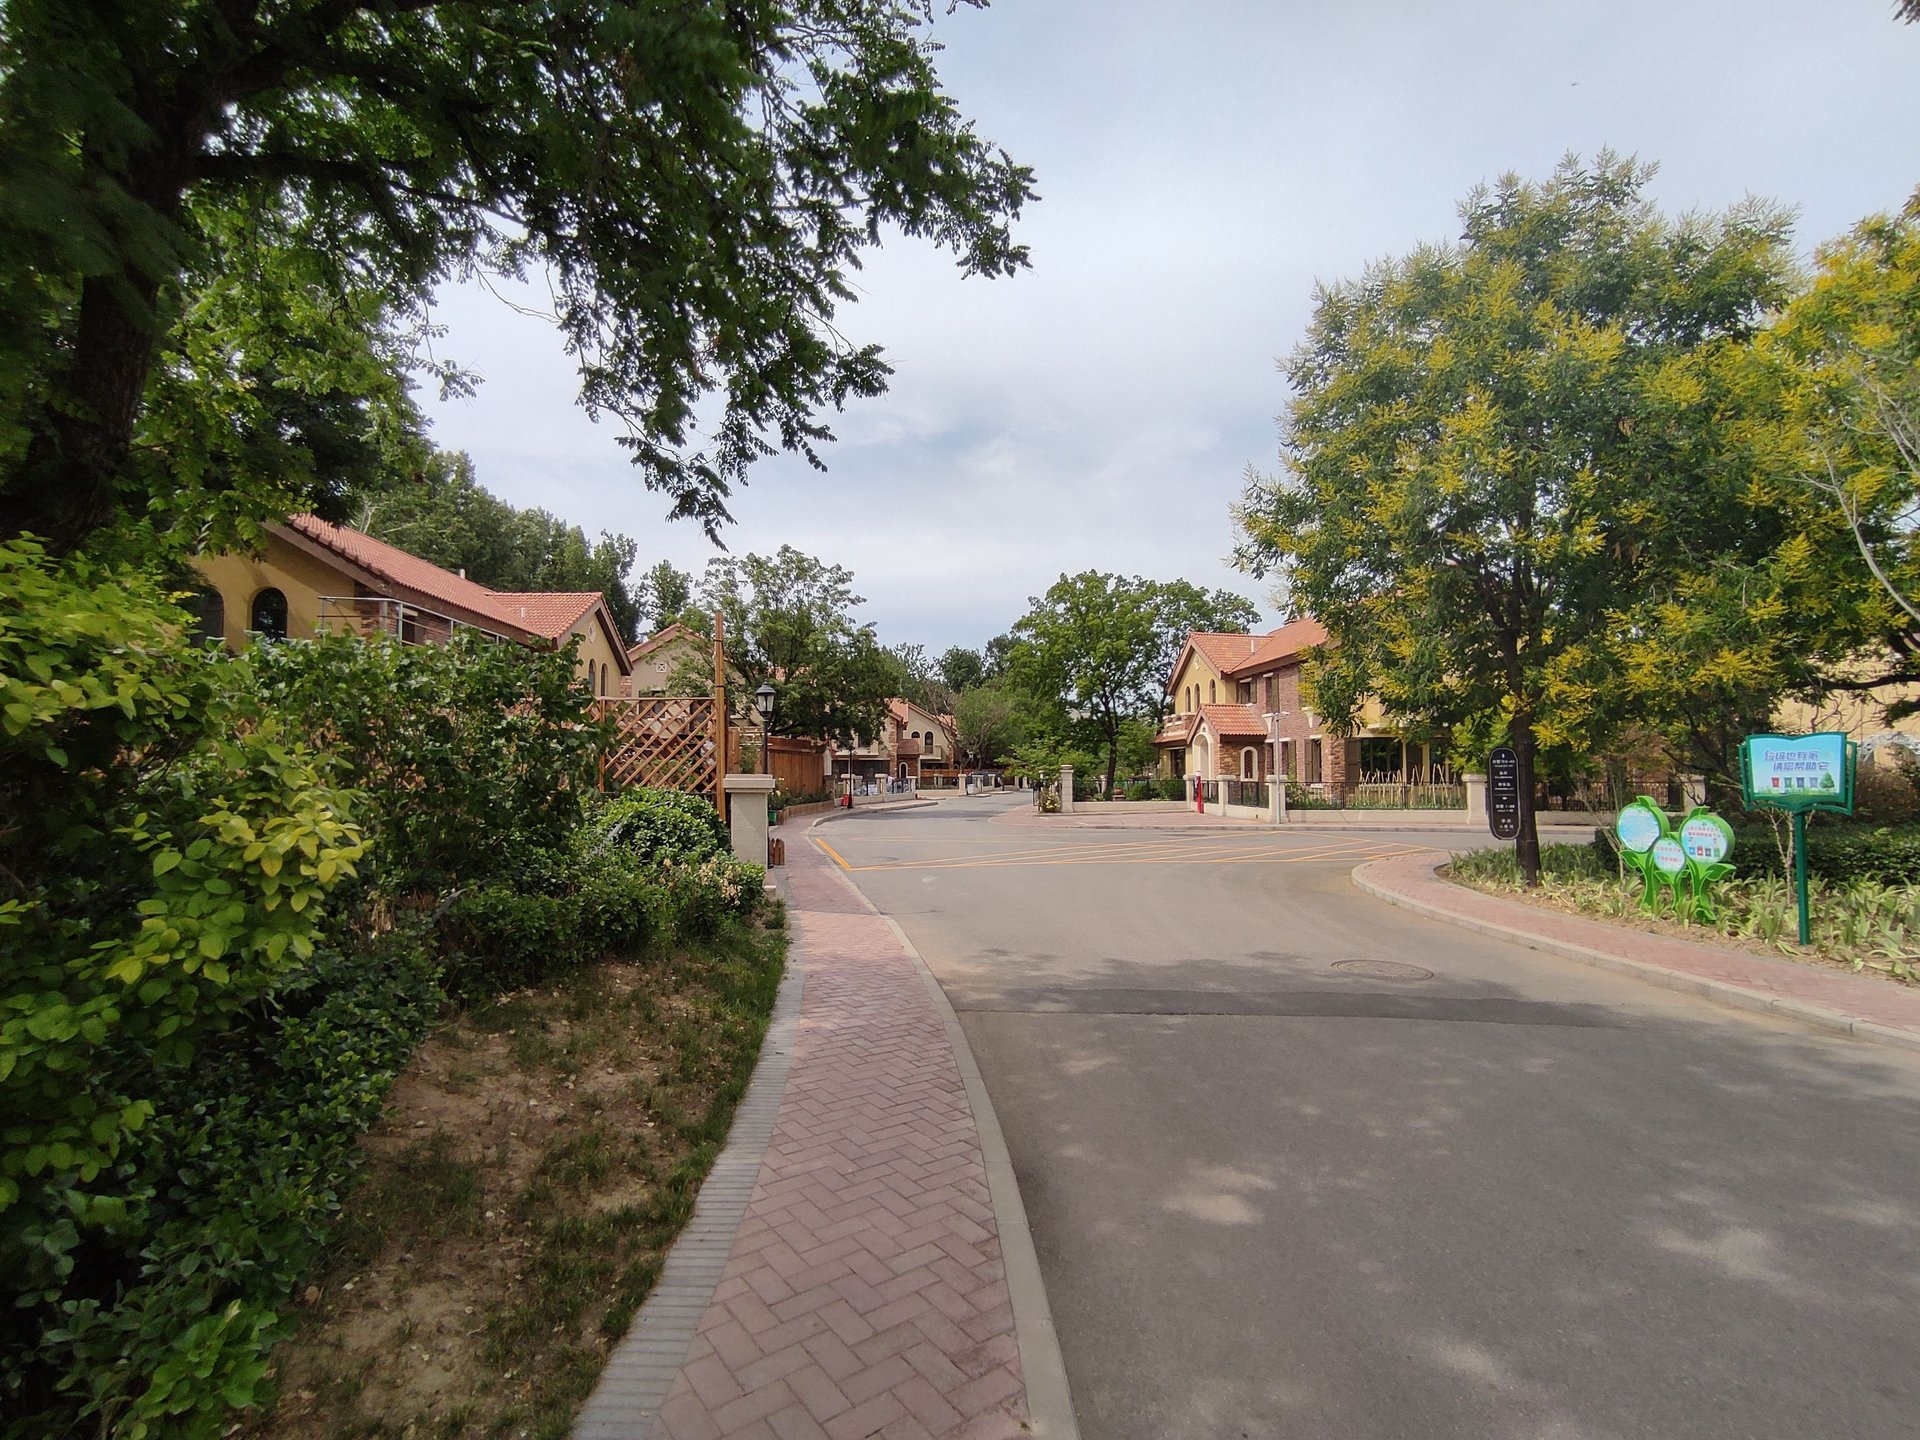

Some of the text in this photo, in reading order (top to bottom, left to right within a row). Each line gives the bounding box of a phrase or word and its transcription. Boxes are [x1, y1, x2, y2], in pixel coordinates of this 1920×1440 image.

[1773, 761, 1829, 771] 请您帮助它
